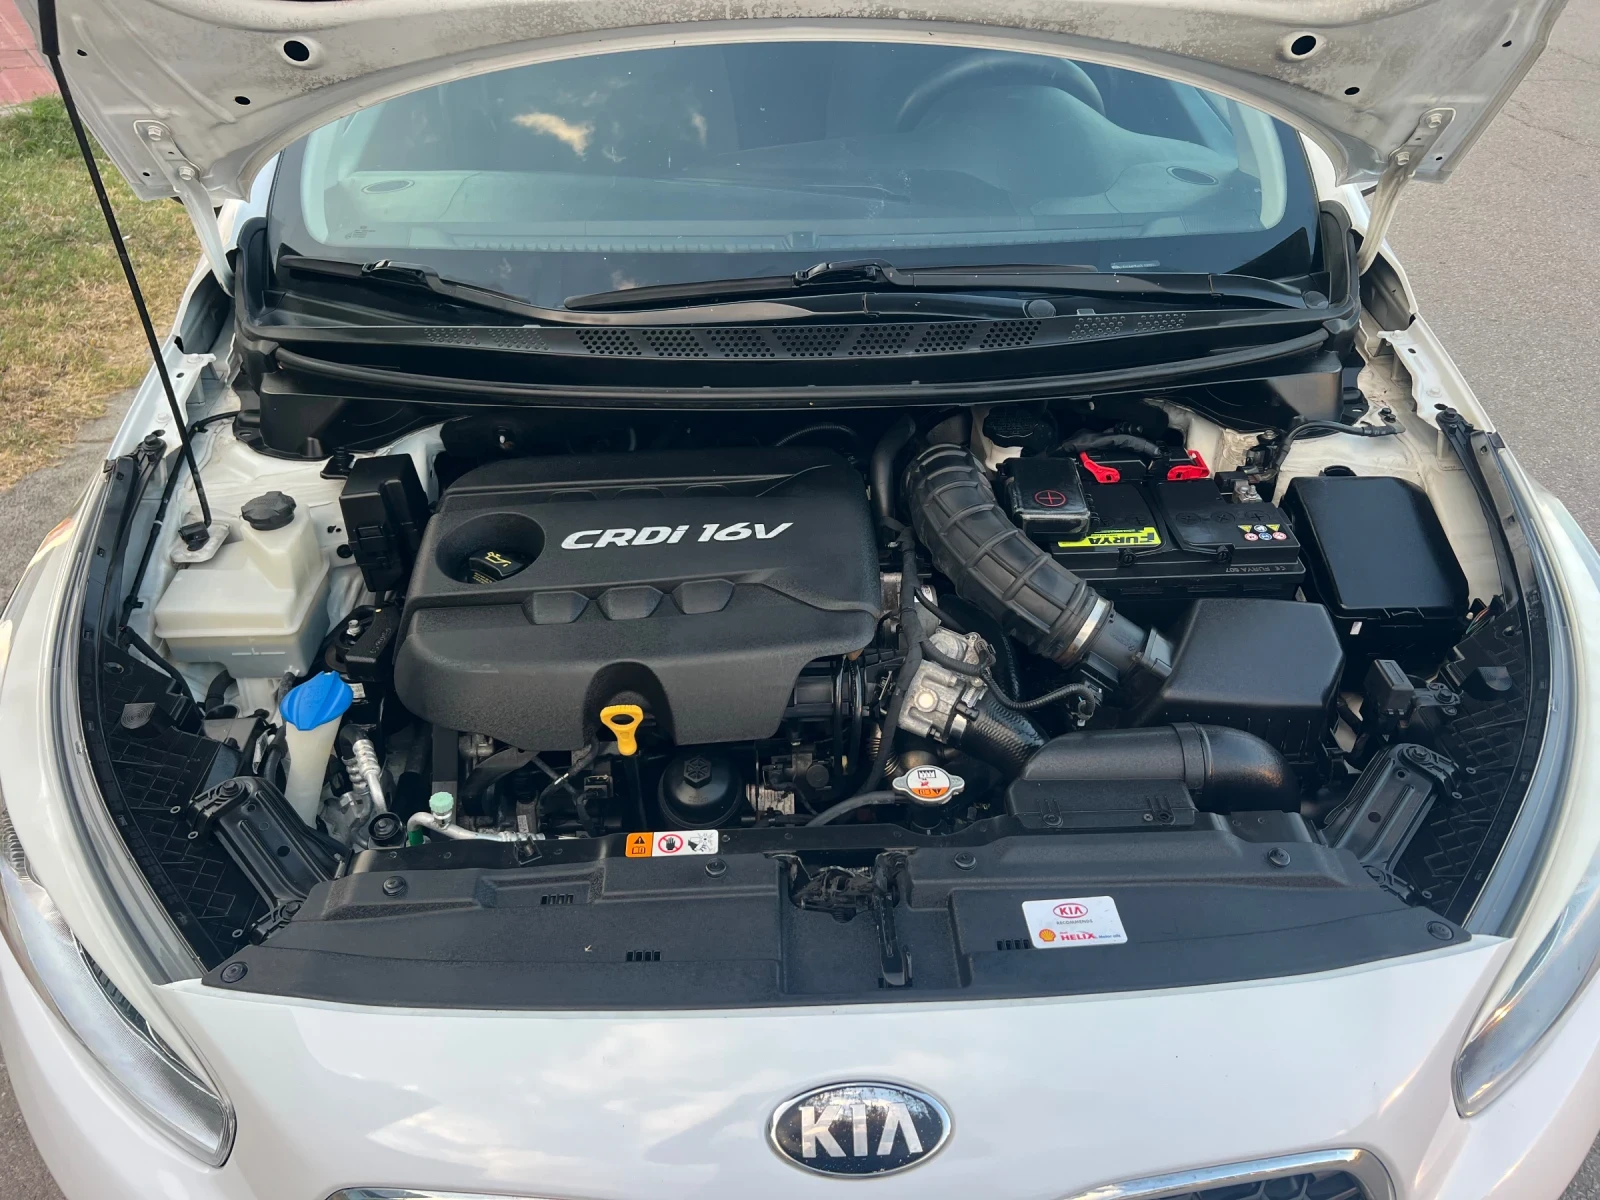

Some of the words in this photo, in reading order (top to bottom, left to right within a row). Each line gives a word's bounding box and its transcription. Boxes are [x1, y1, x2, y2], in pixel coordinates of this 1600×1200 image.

[561, 524, 690, 549] CRDi
[697, 522, 794, 542] 16V
[1088, 532, 1155, 545] FURYA
[1059, 906, 1083, 915] KIA
[1060, 933, 1096, 941] HELIX
[799, 1101, 923, 1158] KIA
